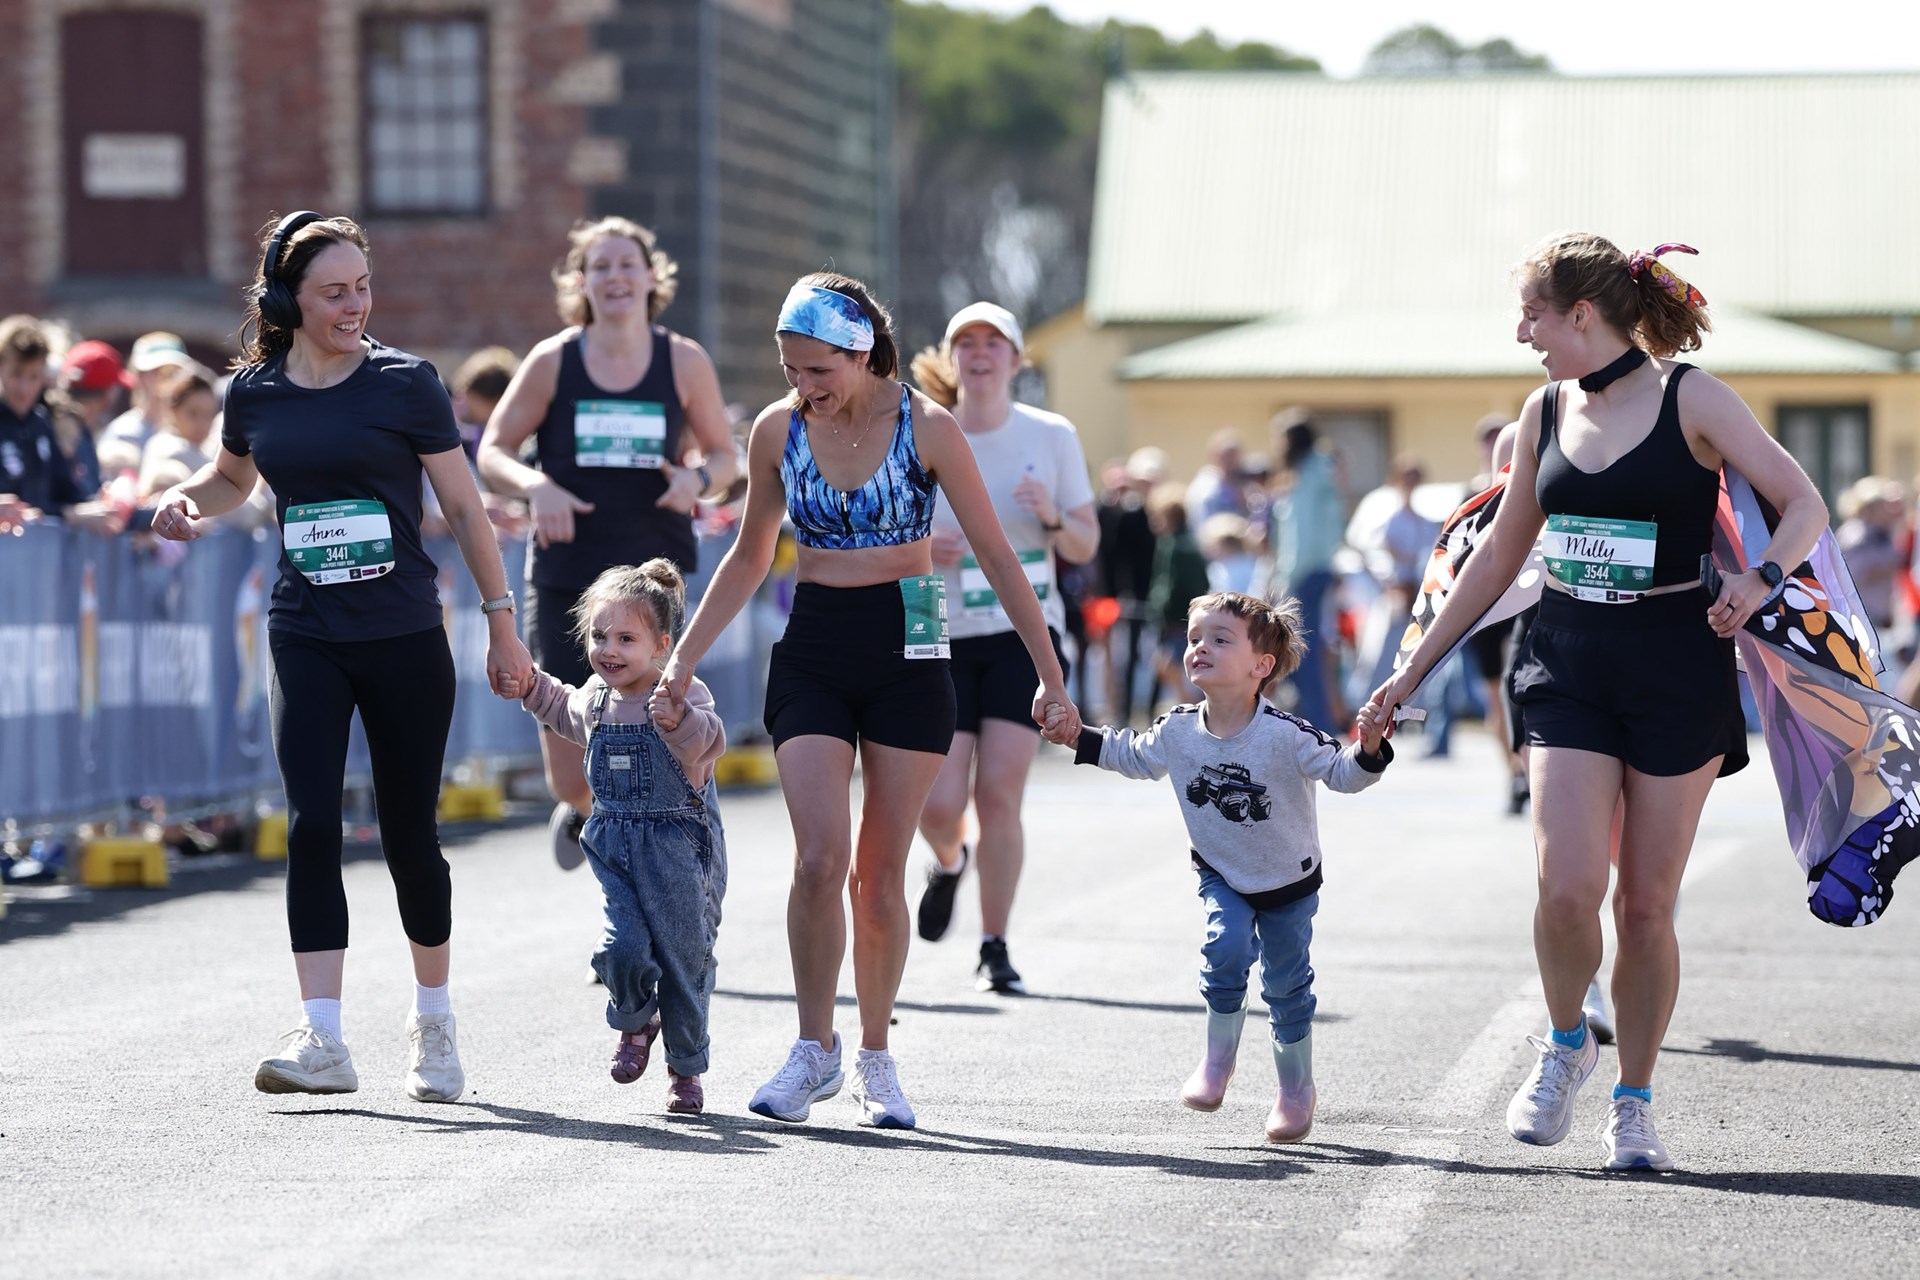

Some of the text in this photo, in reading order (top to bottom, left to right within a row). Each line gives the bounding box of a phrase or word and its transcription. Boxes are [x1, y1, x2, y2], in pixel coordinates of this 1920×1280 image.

[302, 524, 348, 543] Anna
[326, 546, 348, 561] 3441
[1566, 536, 1628, 564] Milly
[1584, 564, 1609, 580] 3544
